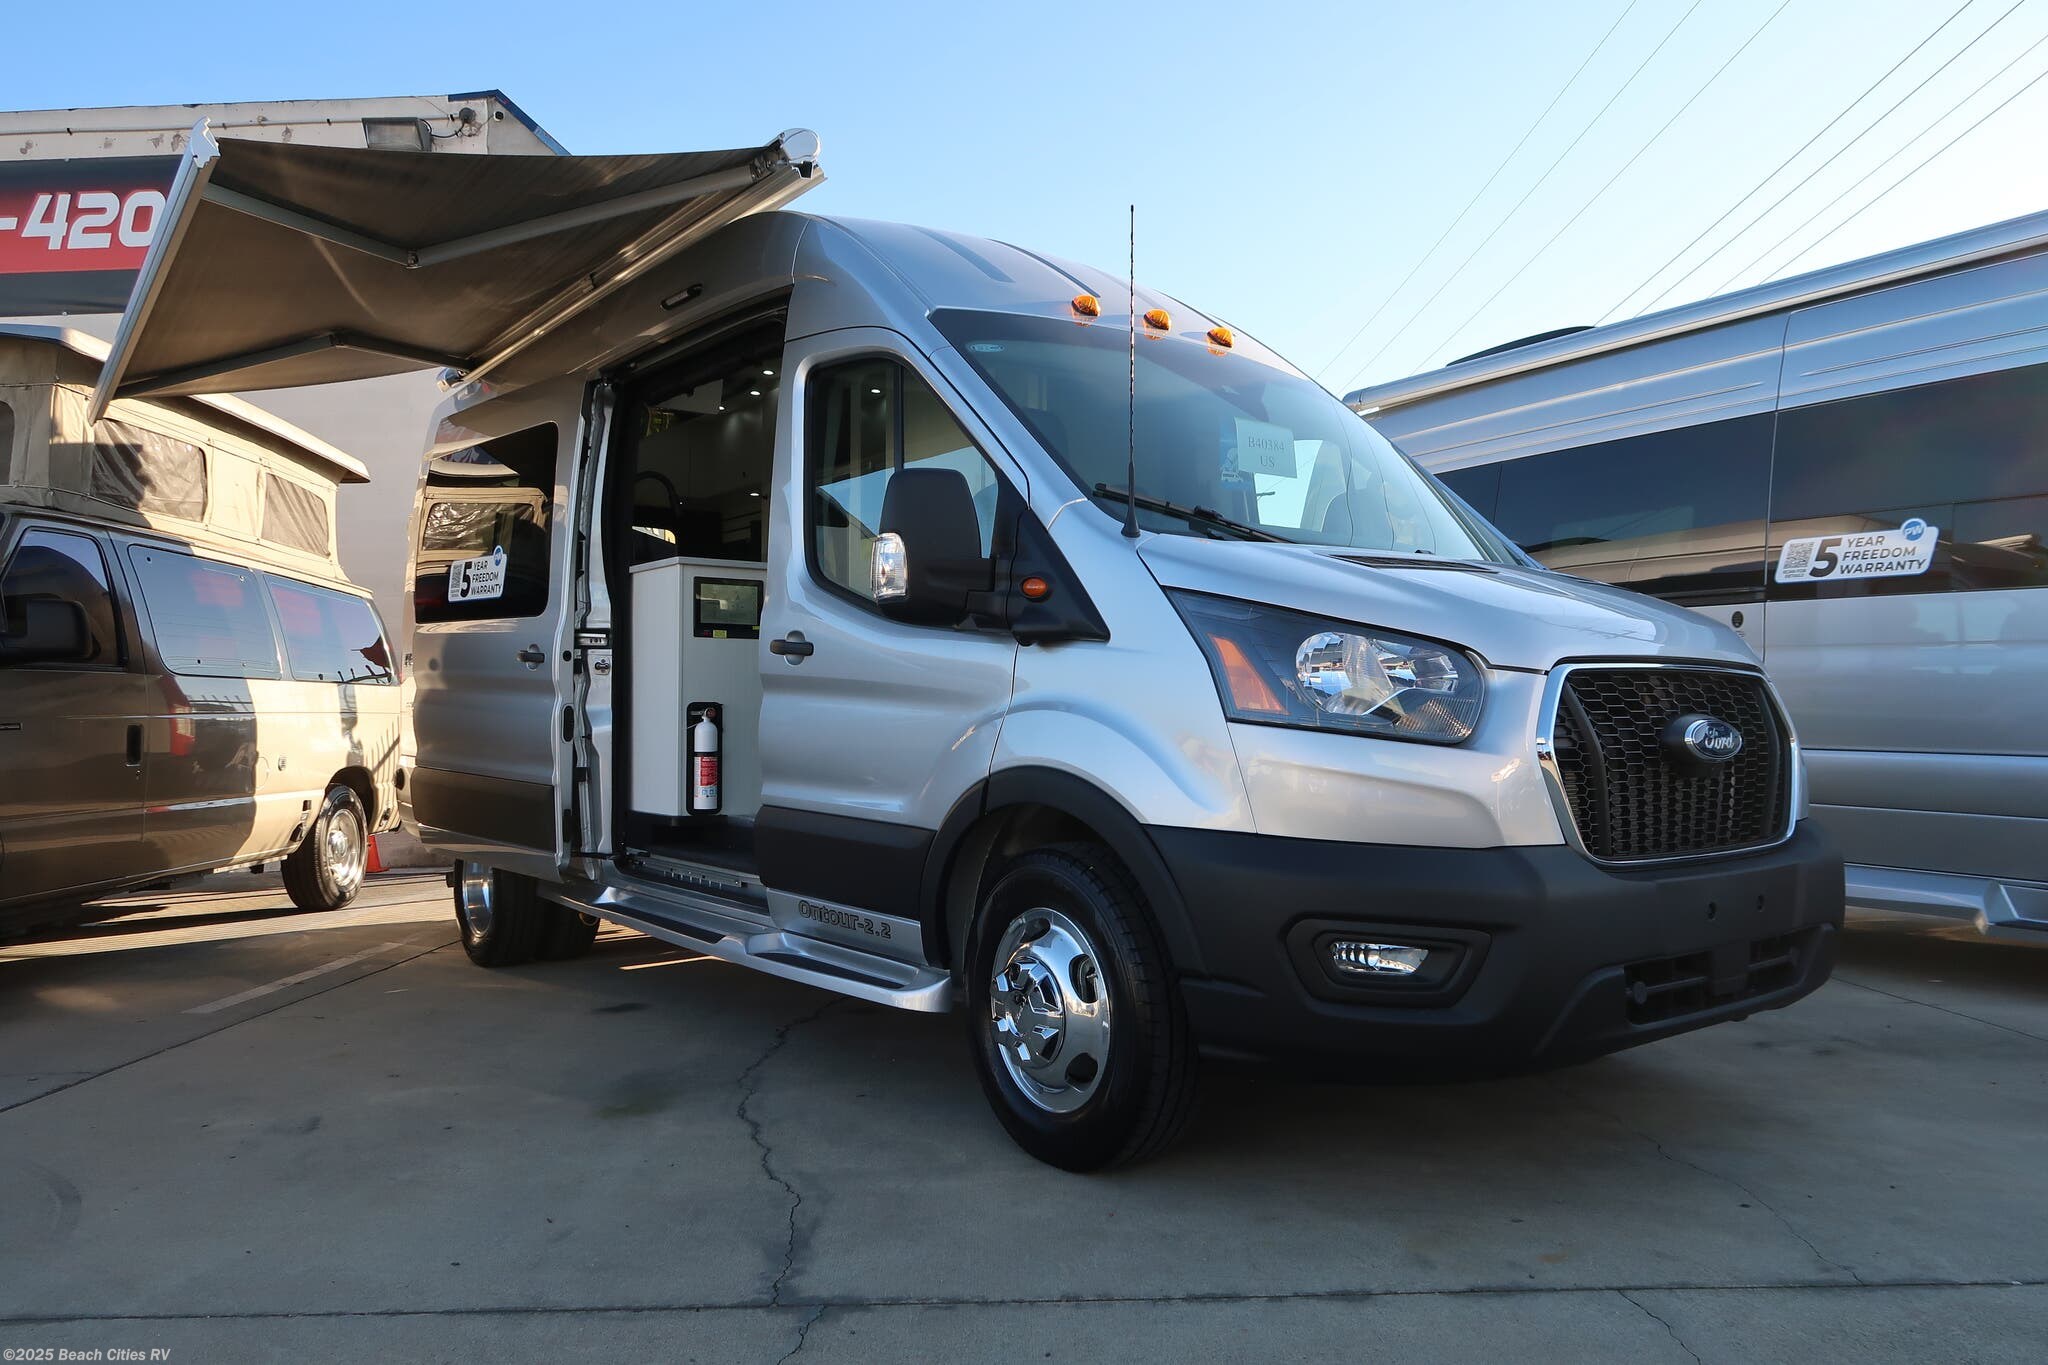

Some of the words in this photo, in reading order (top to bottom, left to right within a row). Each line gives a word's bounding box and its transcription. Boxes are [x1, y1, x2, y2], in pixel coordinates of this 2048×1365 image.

[1260, 455, 1275, 468] US
[1809, 538, 1842, 578] 5
[1847, 535, 1885, 548] YEAR
[1842, 546, 1917, 562] FREEDOM
[1840, 559, 1926, 575] WARRANTY
[460, 561, 473, 598] 5
[473, 560, 489, 571] YEAR
[472, 572, 499, 583] FREEDOM
[471, 584, 502, 595] WARRANTY
[1700, 726, 1735, 750] Ford
